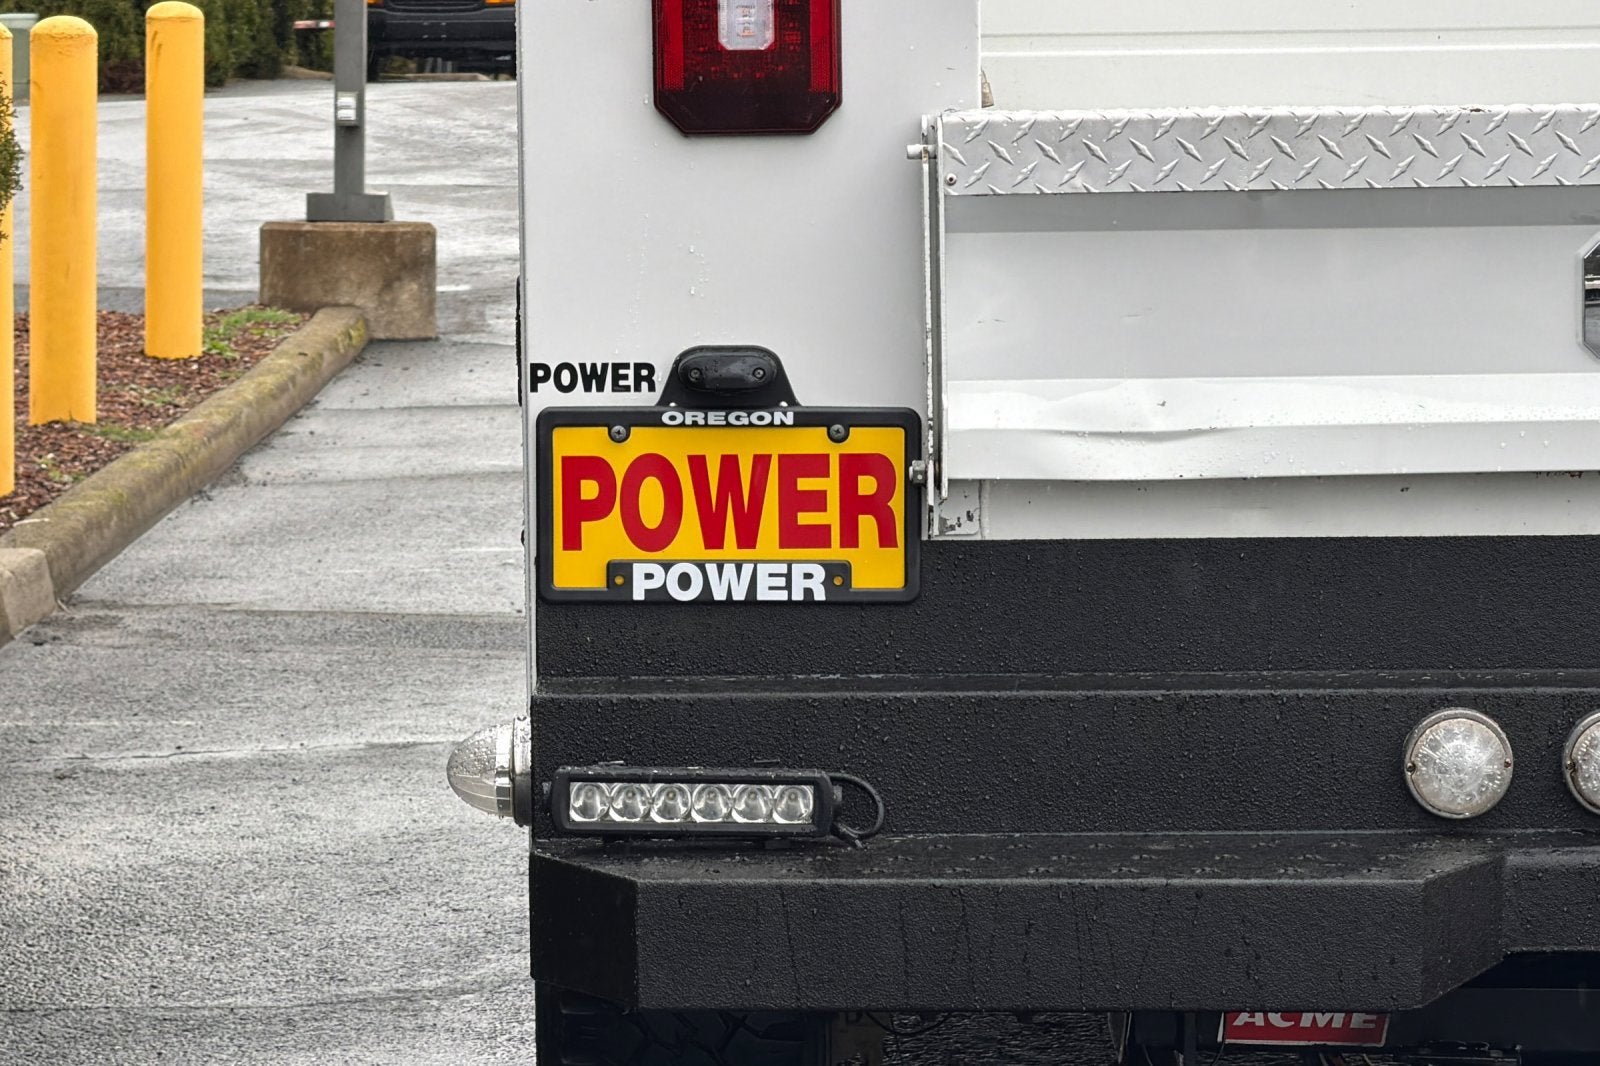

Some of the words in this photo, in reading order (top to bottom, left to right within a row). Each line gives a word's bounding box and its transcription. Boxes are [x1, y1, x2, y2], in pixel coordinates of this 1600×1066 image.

[529, 362, 656, 393] POWER
[661, 411, 794, 426] OREGON
[561, 452, 899, 552] POWER
[632, 562, 826, 601] POWER
